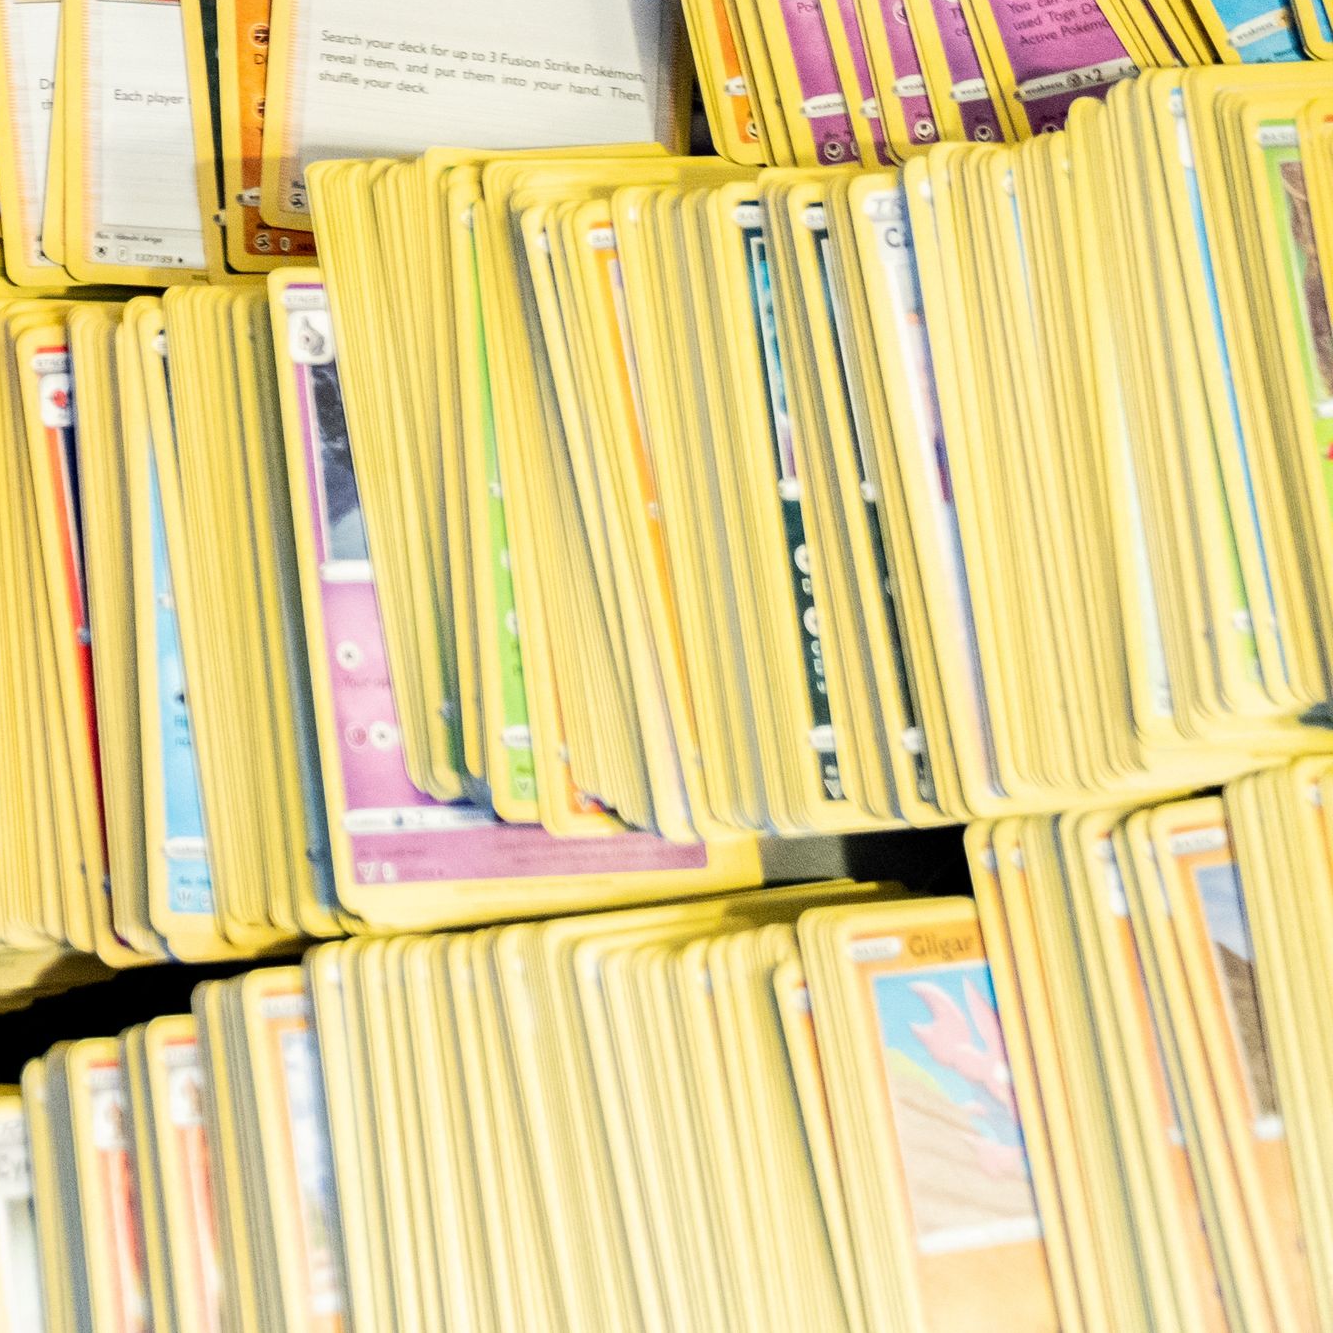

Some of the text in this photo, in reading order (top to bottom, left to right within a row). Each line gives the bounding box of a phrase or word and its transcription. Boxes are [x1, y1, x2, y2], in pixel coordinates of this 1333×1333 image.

[1006, 1, 1032, 14] You
[1012, 16, 1043, 32] used
[1019, 31, 1058, 47] Active
[321, 29, 363, 47] Search
[365, 36, 394, 52] your
[398, 39, 427, 56] deck
[430, 43, 450, 59] for
[500, 52, 541, 69] Fusion
[543, 57, 580, 76] Strike
[318, 69, 430, 95] shuffle your deck.
[319, 50, 358, 66] reveal
[363, 56, 400, 71] them,
[405, 61, 429, 76] and
[434, 66, 456, 82] put
[462, 69, 496, 84] them
[501, 73, 527, 88] into
[532, 80, 563, 94] your
[568, 81, 603, 97] hand.
[113, 87, 184, 107] Each player
[906, 933, 974, 962] Gligar
